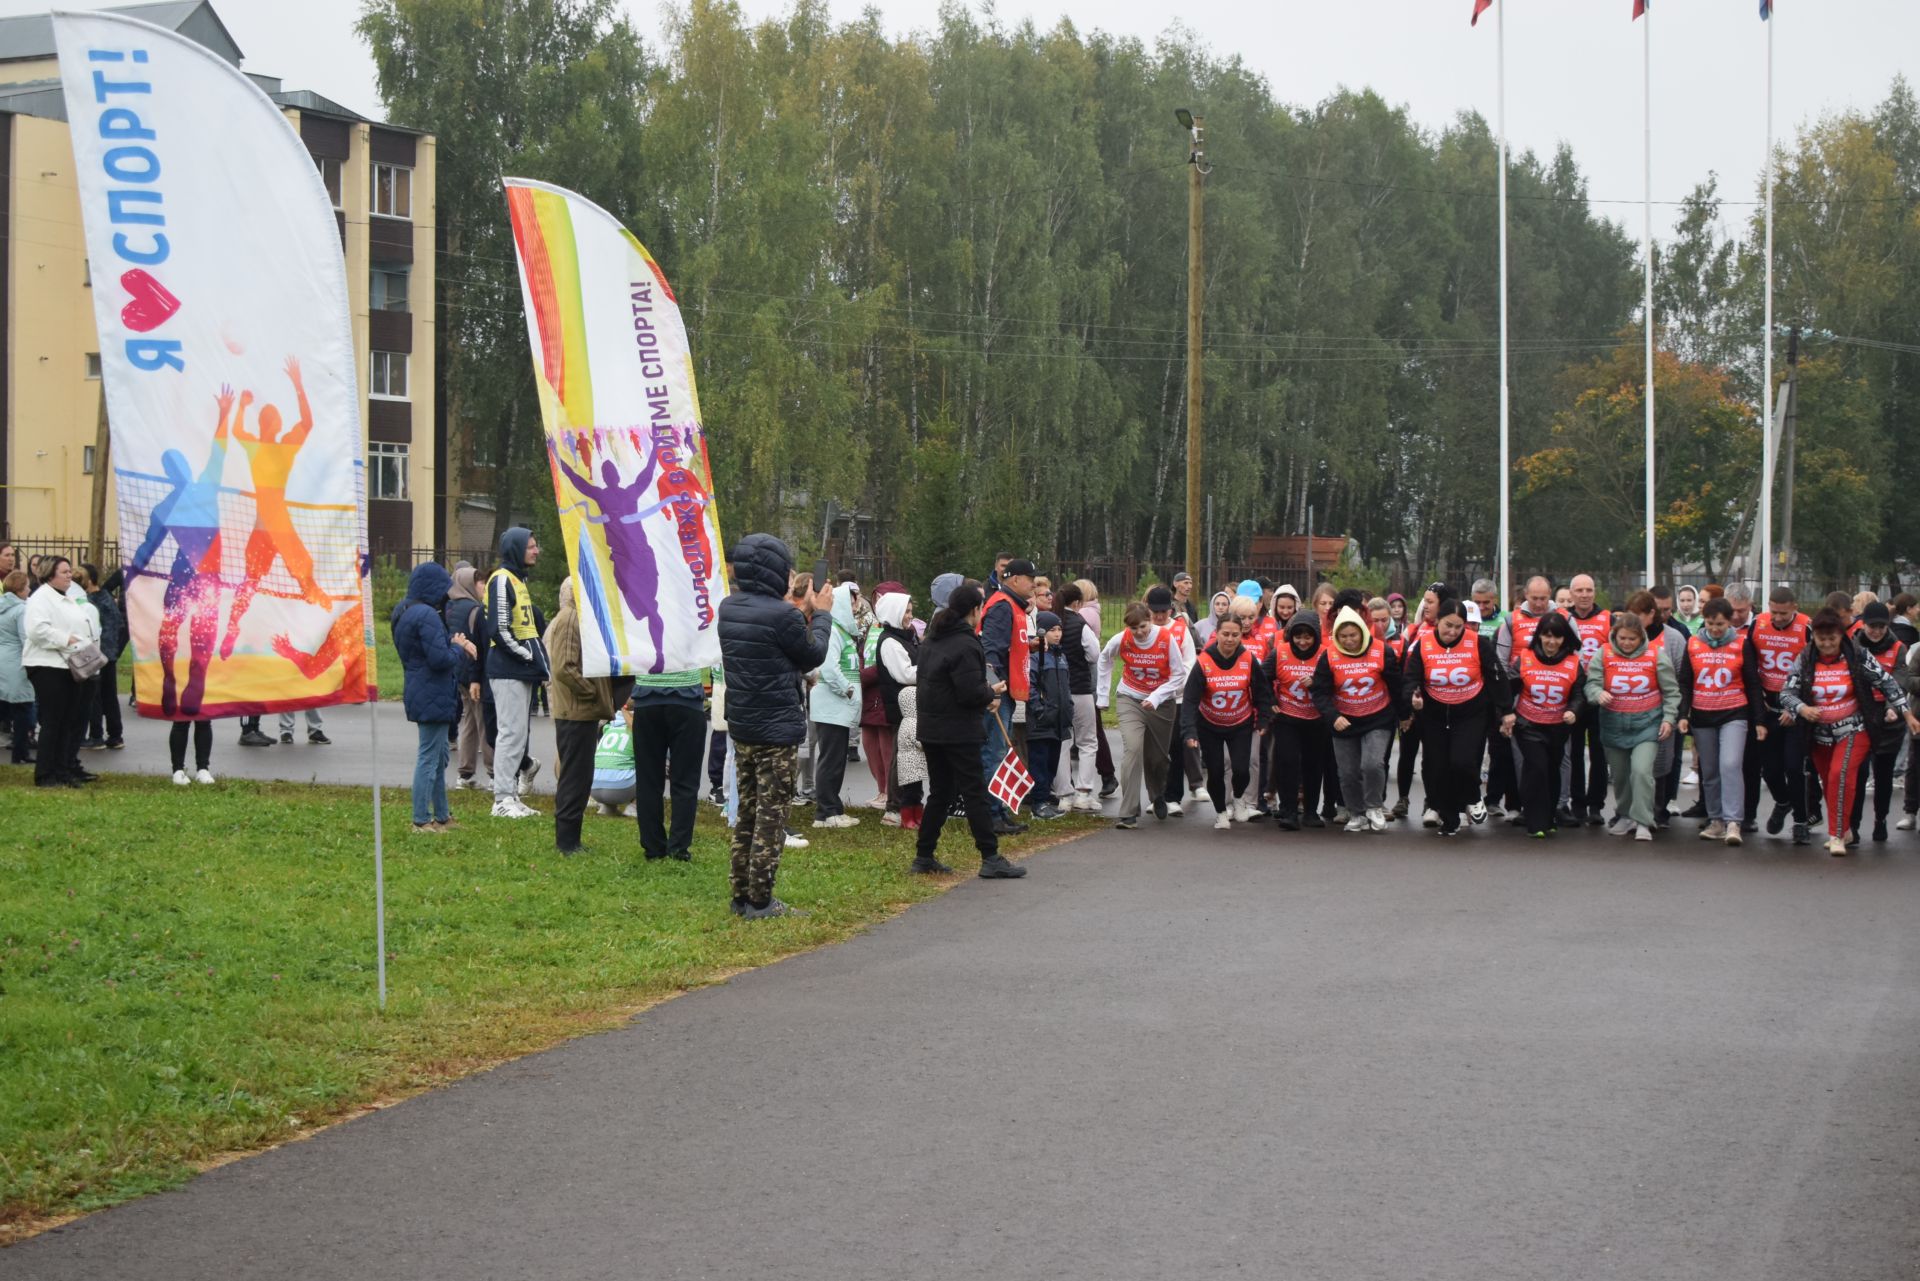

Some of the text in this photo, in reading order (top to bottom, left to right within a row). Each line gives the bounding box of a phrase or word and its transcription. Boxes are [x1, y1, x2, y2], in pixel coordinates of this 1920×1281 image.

[88, 49, 186, 374] Я СПОРТ!
[630, 281, 711, 632] МОЛОДЕЖЬ В РИТМЕ СПОРТА!
[1759, 634, 1799, 644] ТУКАЕВСКИЙ
[1335, 661, 1378, 670] ТУКАЕВСКИЙ
[1427, 652, 1472, 660] ТУКАЕВСКИЙ
[1760, 649, 1794, 672] 36
[1206, 674, 1248, 683] ТУКАЕВСКИЙ
[1429, 666, 1471, 687] 56
[1527, 669, 1570, 679] ТУКАЕВСКИЙ
[1696, 667, 1733, 689] 40
[1288, 680, 1313, 700] 4
[1340, 676, 1375, 697] 42
[1530, 684, 1564, 705] 55
[1610, 675, 1650, 694] 52
[1811, 684, 1848, 703] 27
[1211, 690, 1244, 710] 67
